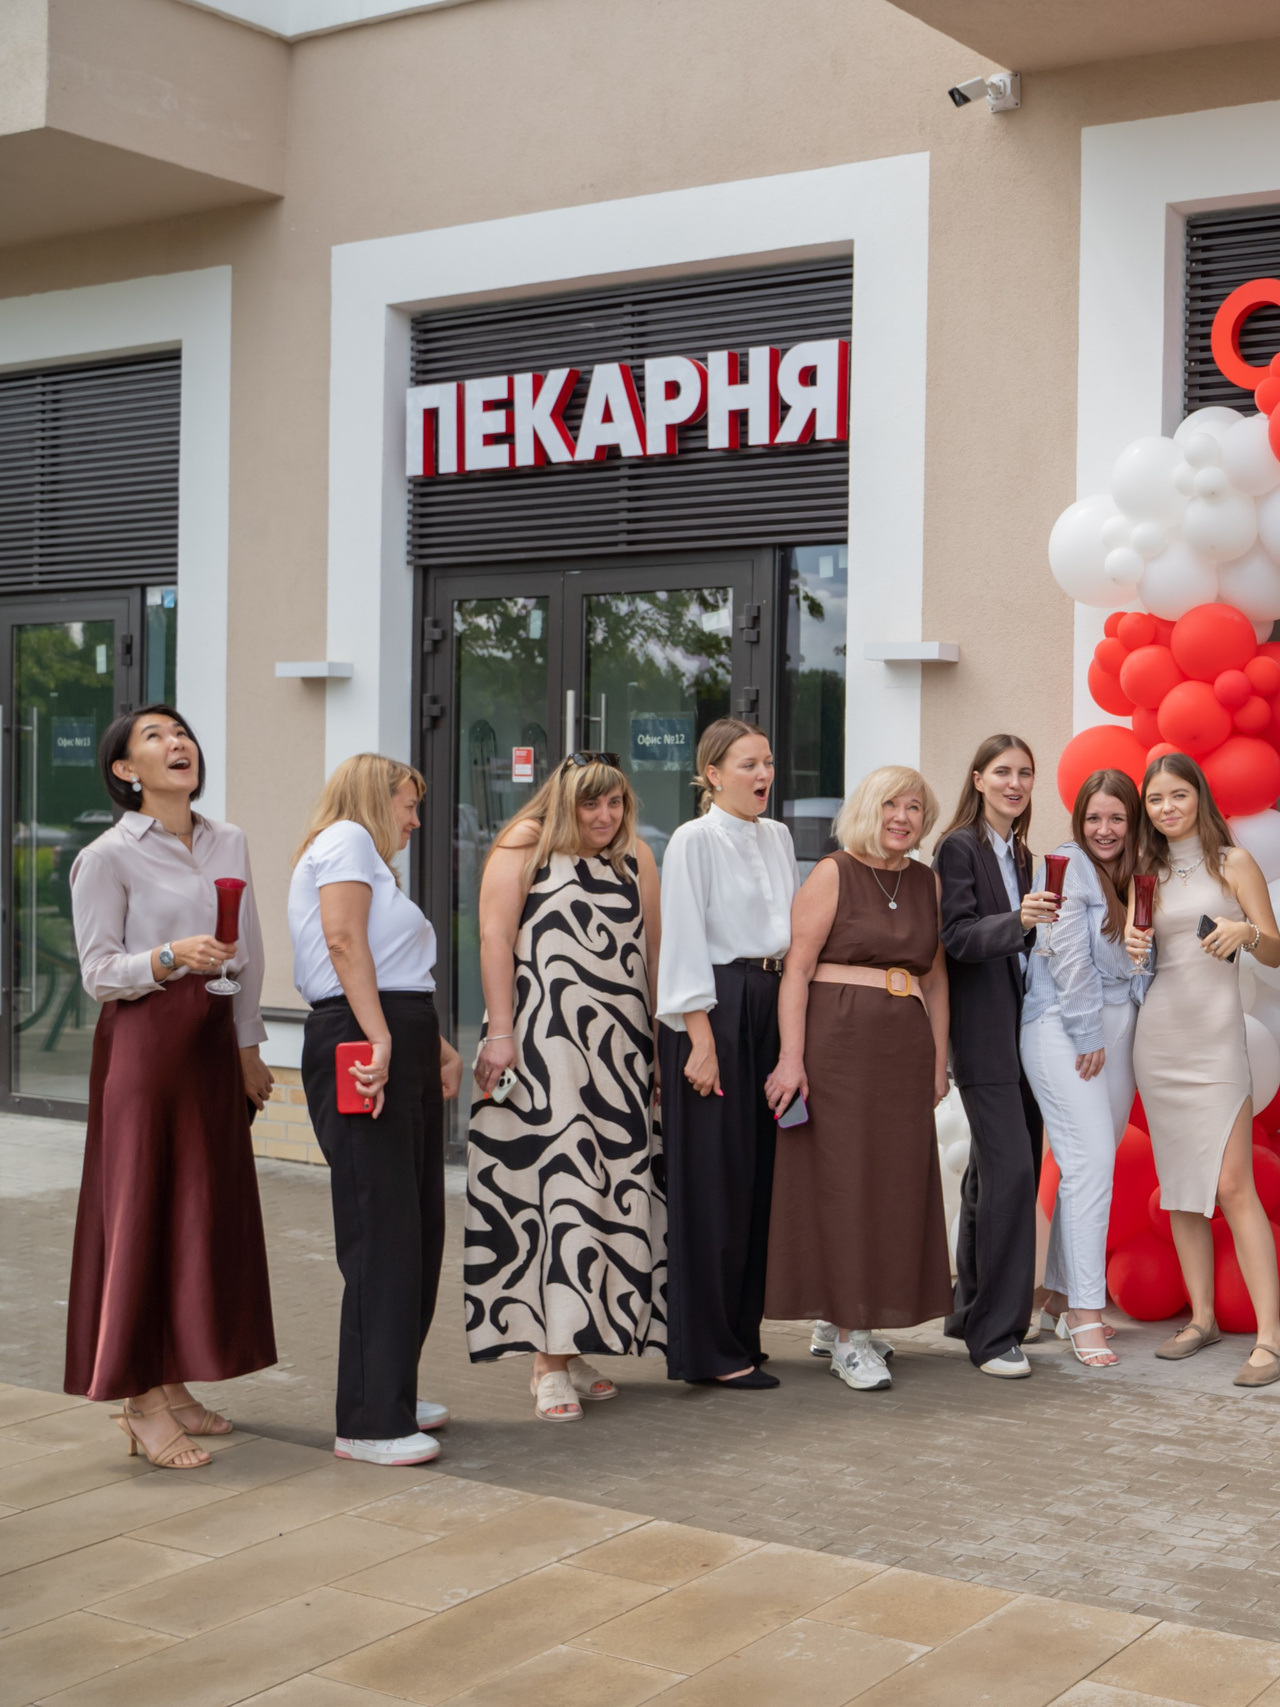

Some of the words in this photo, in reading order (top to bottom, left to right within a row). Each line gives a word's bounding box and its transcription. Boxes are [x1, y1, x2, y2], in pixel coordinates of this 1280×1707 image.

[406, 338, 849, 477] ПЕКАРНЯ
[637, 734, 662, 747] Офис
[664, 734, 685, 744] №12
